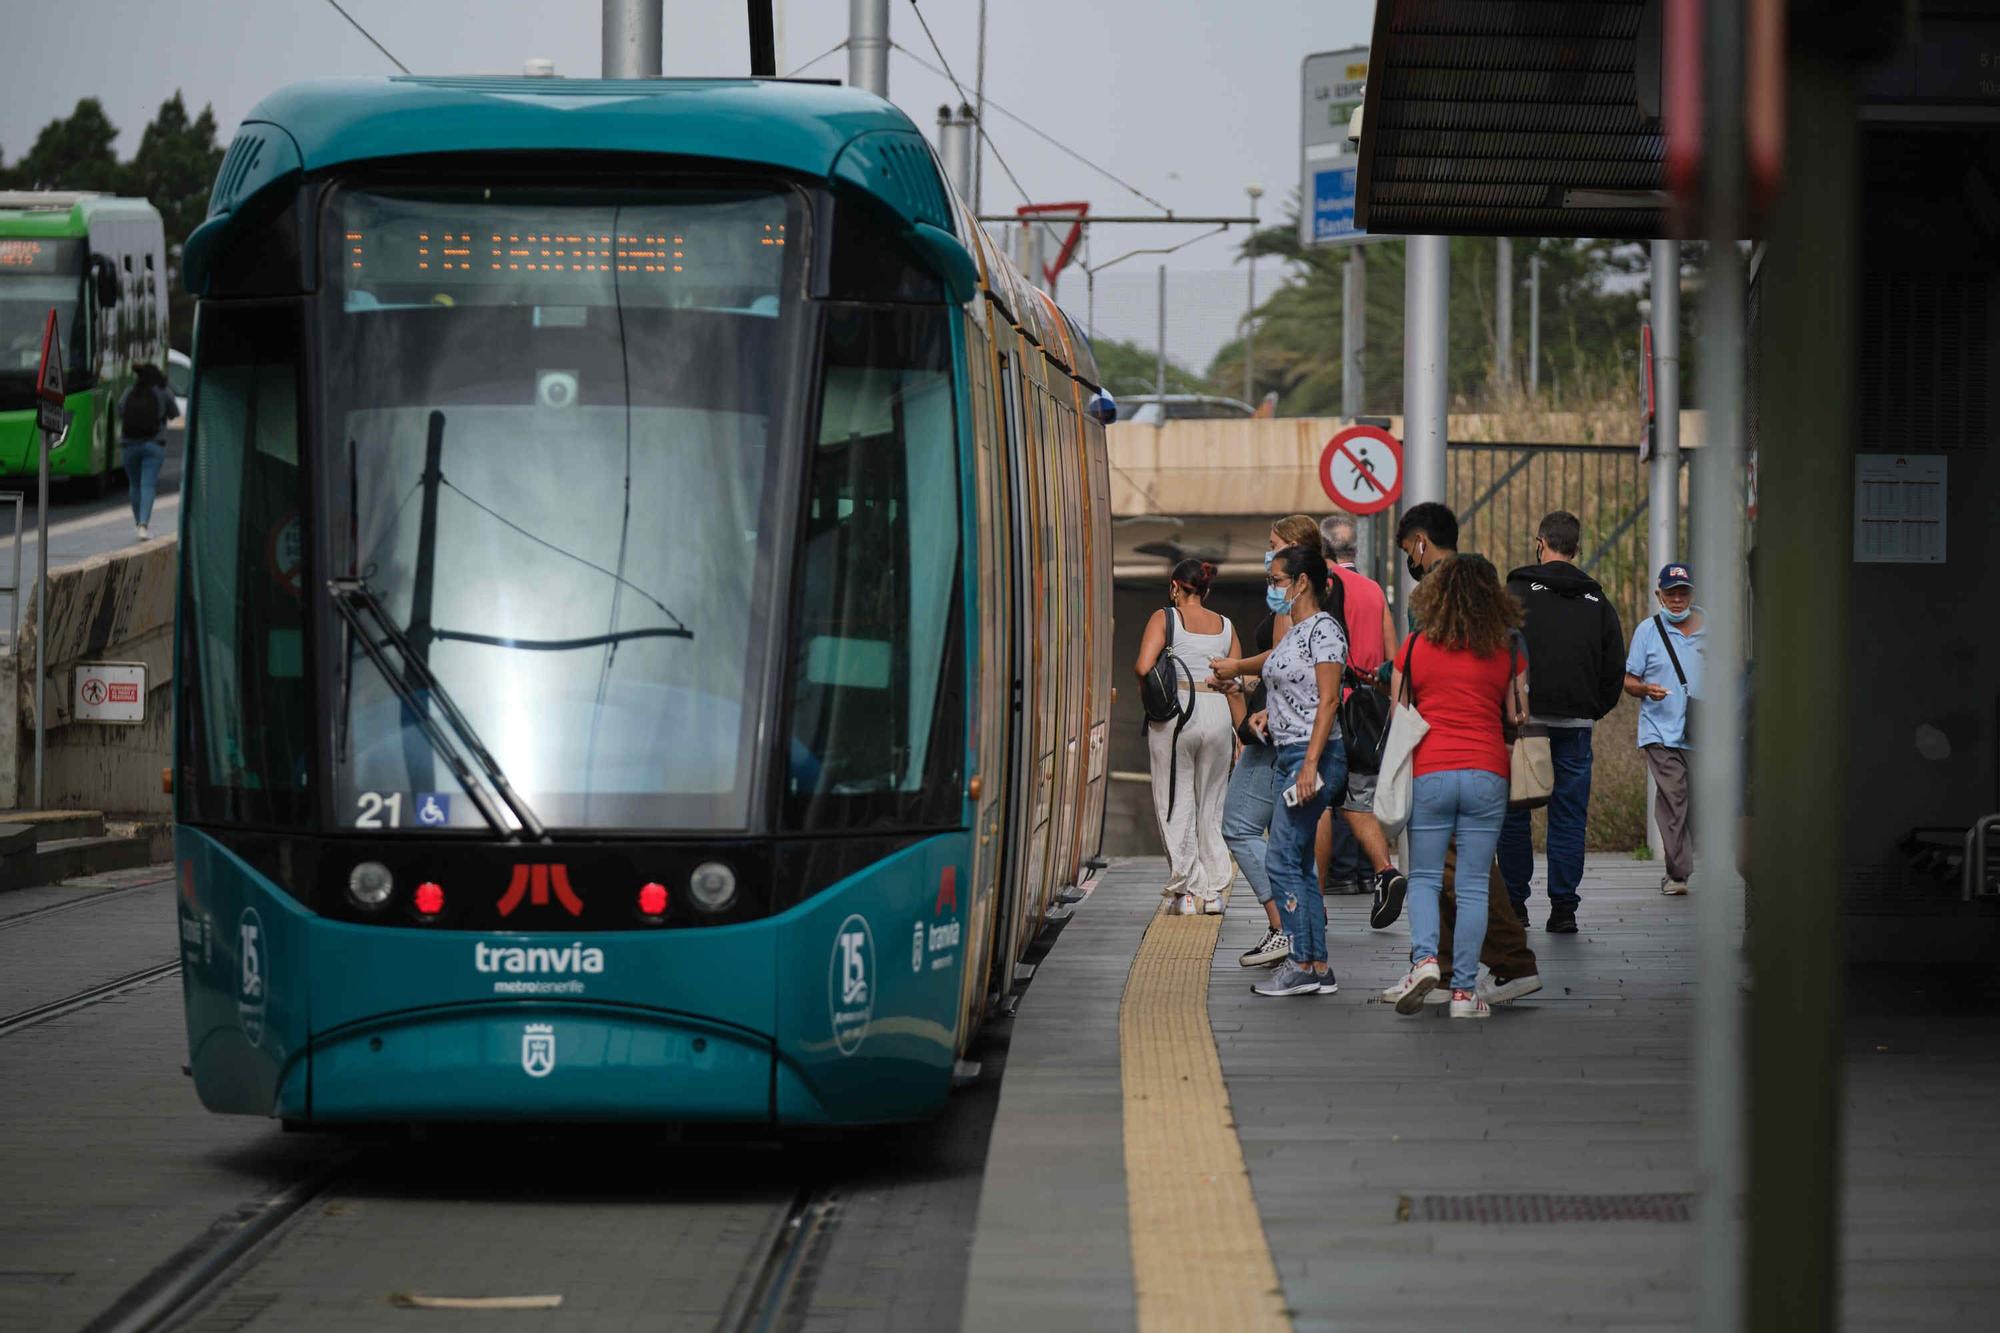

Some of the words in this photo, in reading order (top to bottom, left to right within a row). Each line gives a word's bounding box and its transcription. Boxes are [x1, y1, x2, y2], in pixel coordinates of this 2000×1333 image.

[355, 792, 402, 828] 21
[475, 942, 605, 973] tranvía
[494, 979, 585, 993] metrotenerife
